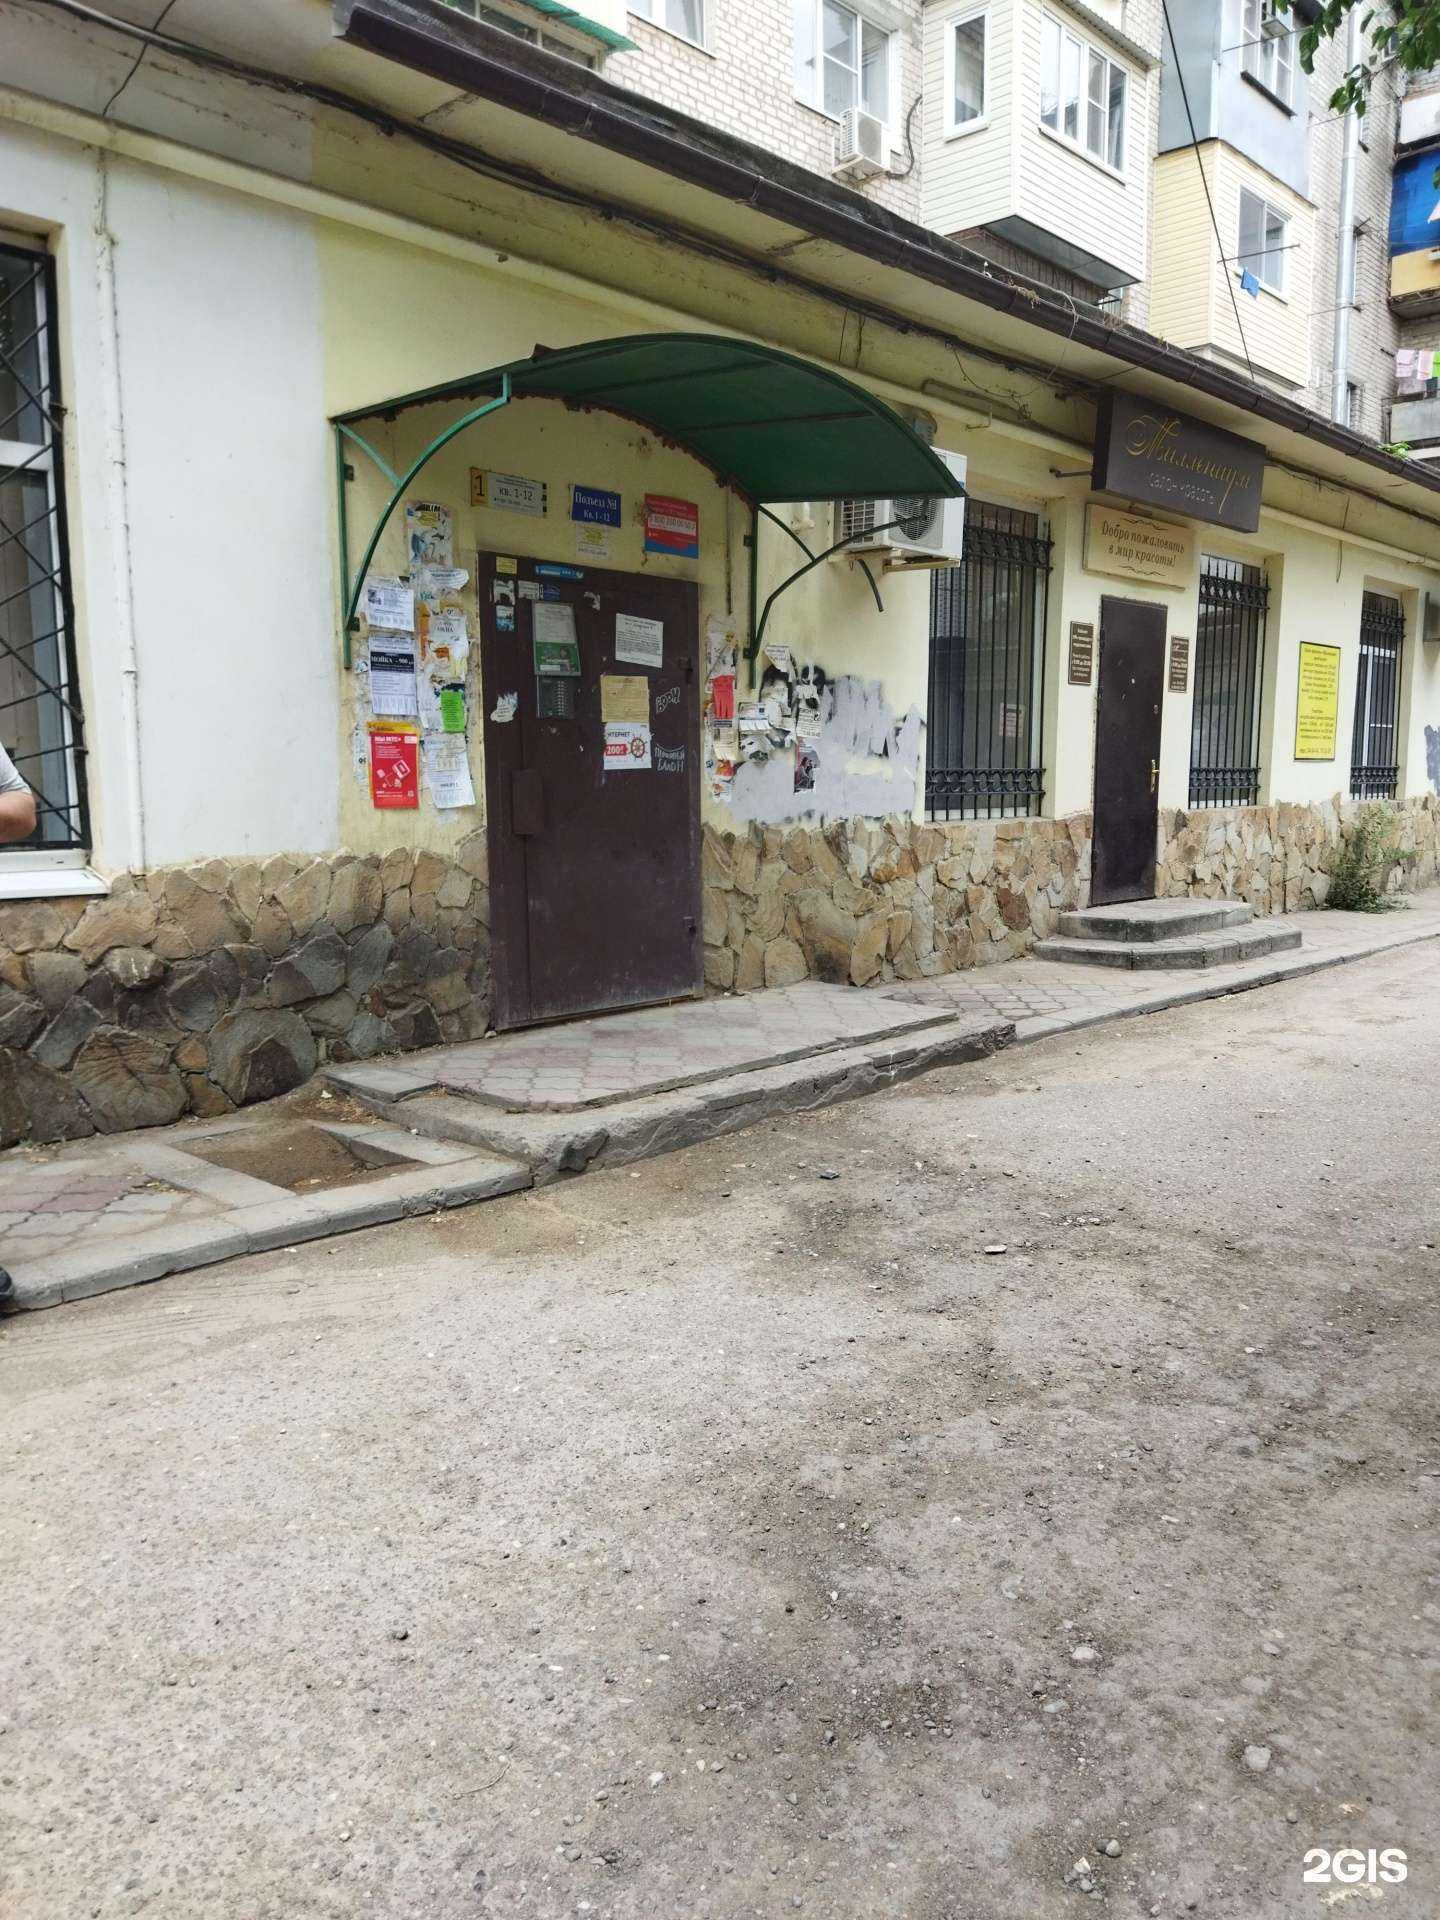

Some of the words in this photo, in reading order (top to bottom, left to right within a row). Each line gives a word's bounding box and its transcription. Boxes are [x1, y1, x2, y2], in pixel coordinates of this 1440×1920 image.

[475, 474, 485, 497] 1
[1102, 519, 1130, 540] Добро
[1130, 532, 1185, 555] пожаловать
[1108, 544, 1114, 554] в
[1115, 546, 1134, 562] мир
[1135, 550, 1177, 568] красоты!
